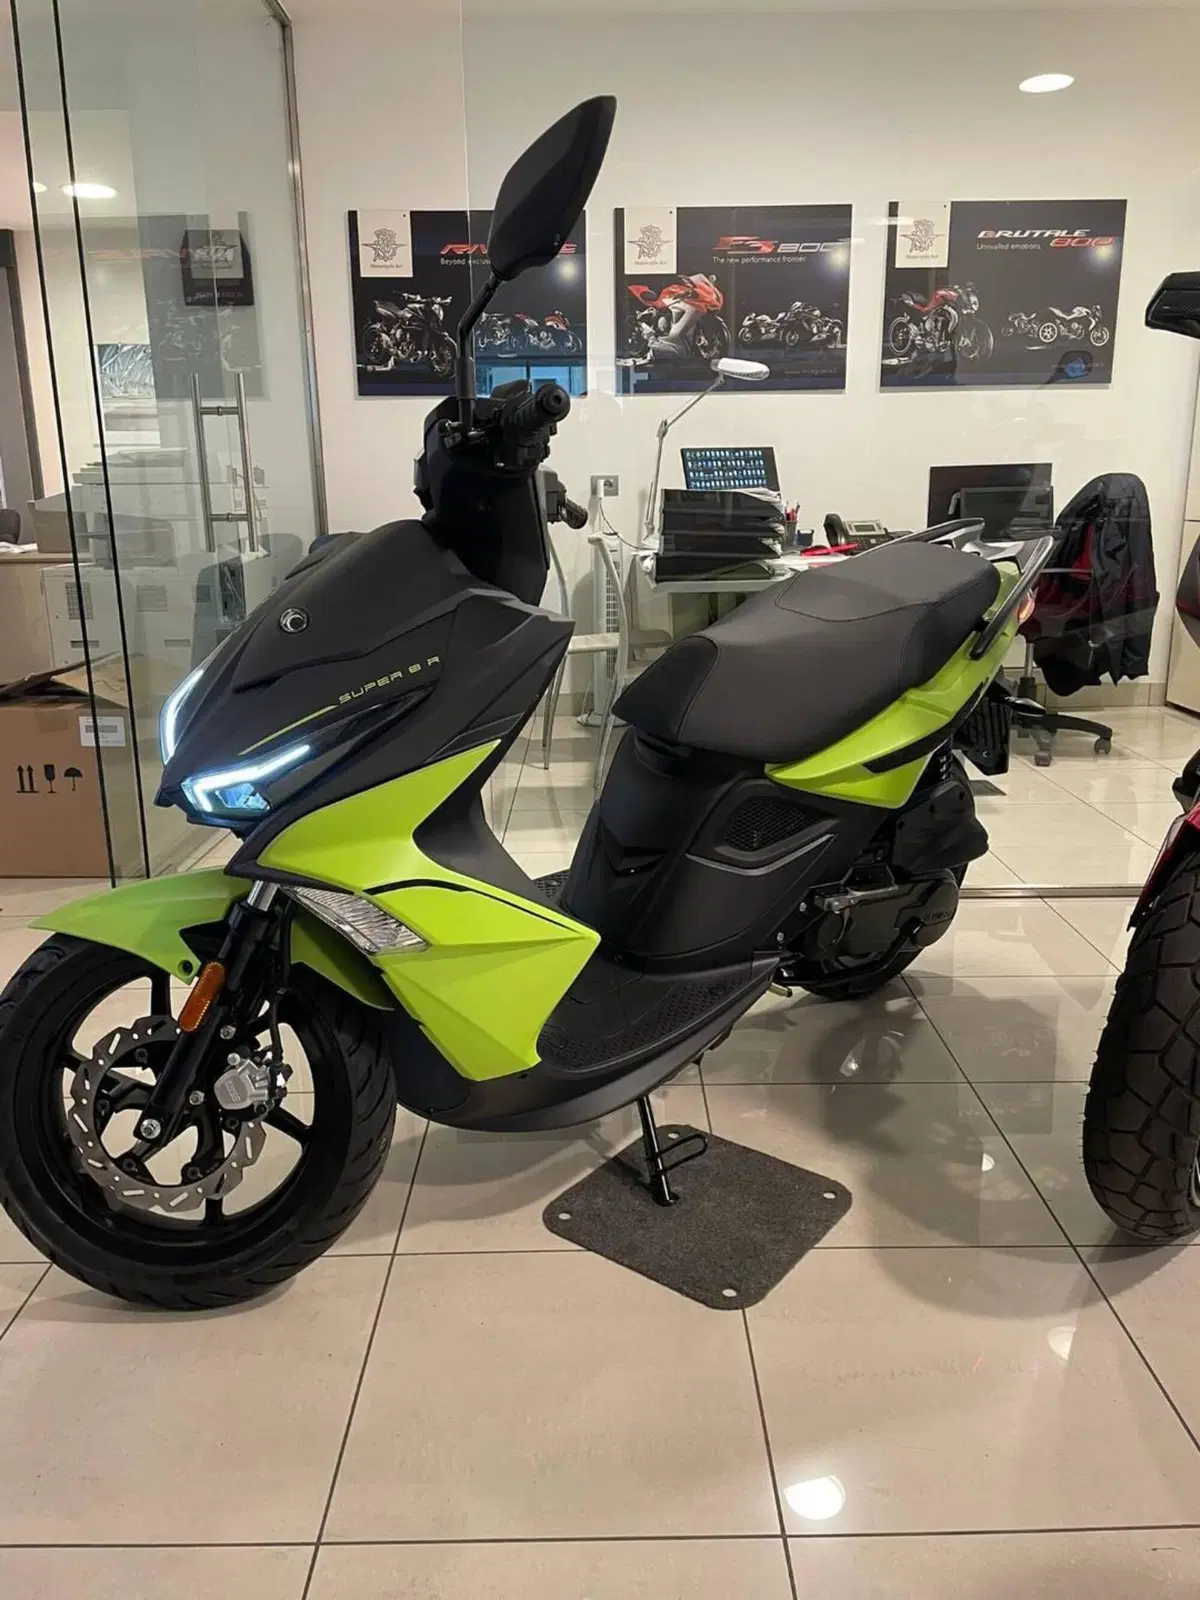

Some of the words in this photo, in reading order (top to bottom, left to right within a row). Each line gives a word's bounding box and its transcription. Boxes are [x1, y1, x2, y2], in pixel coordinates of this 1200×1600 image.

[977, 229, 1090, 238] BRUTALE
[777, 241, 844, 253] 800
[1010, 242, 1041, 250] emotions
[1050, 236, 1116, 248] 800
[440, 243, 577, 254] RIVE
[440, 257, 466, 266] Beyond
[468, 257, 490, 265] exclusi
[713, 256, 724, 264] The
[741, 255, 780, 265] performance
[782, 254, 806, 263] frontier
[339, 671, 402, 703] SUPER
[408, 663, 421, 674] 8
[427, 656, 440, 666] R
